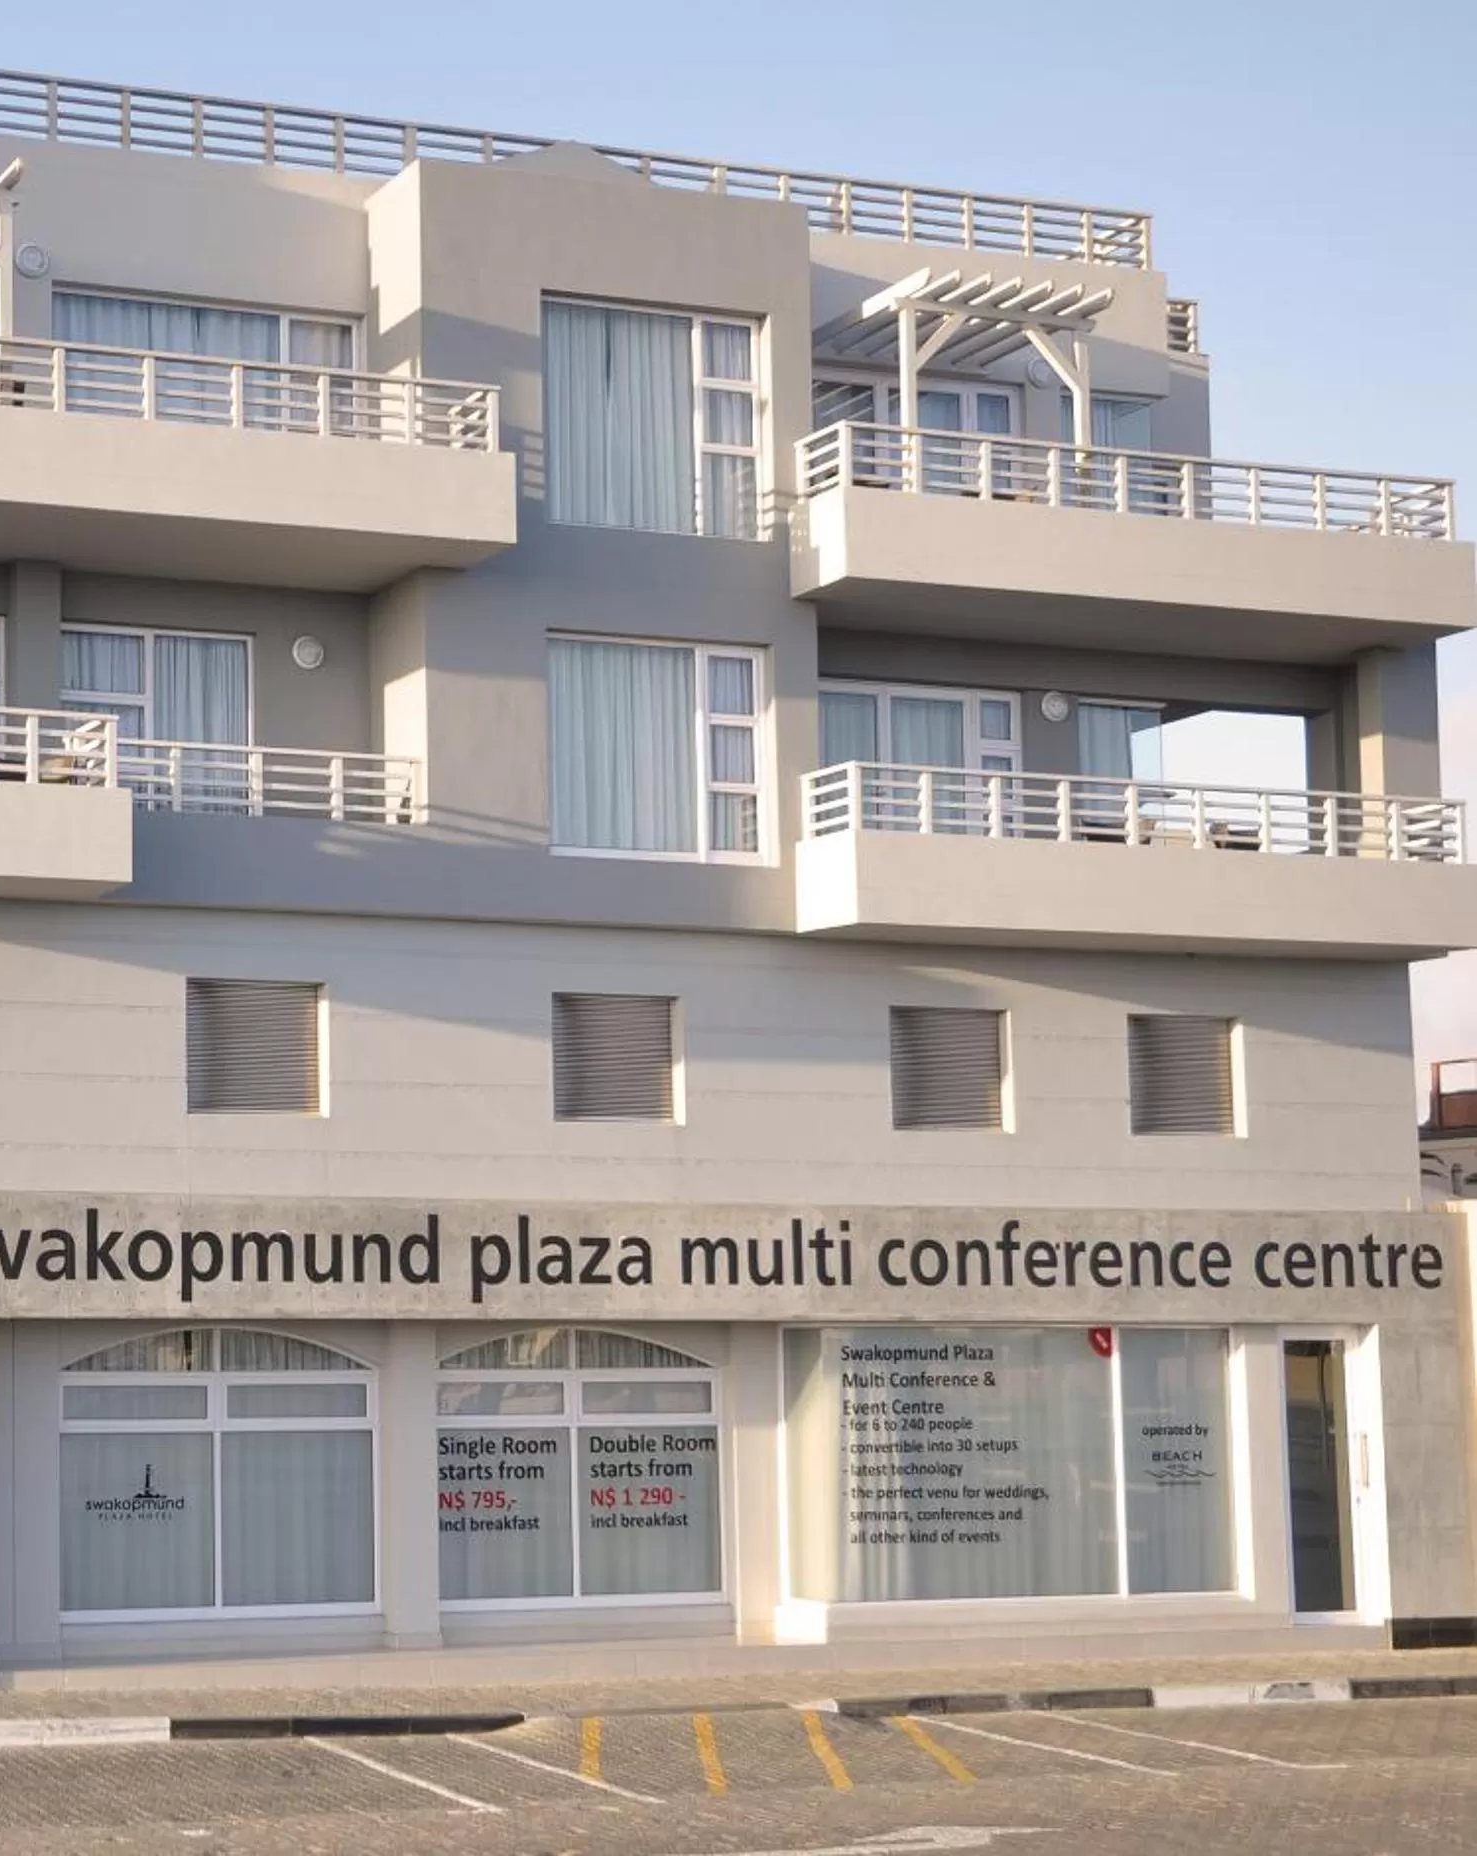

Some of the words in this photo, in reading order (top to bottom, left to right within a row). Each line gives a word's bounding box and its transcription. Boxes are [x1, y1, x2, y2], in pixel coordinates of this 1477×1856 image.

[472, 1215, 654, 1303] plaza
[680, 1218, 853, 1286] multi
[878, 1220, 1233, 1288] conference
[1255, 1231, 1443, 1289] centre
[841, 1344, 948, 1364] Swakopmund
[953, 1344, 994, 1360] Plaza
[842, 1372, 885, 1388] Multi
[890, 1371, 979, 1388] Conference
[983, 1371, 996, 1387] &
[842, 1400, 887, 1416] Event
[892, 1399, 944, 1414] Centre
[850, 1418, 867, 1431] for
[884, 1419, 897, 1431] to
[901, 1418, 925, 1431] 240
[928, 1416, 973, 1433] people
[1141, 1424, 1192, 1438] operated
[1195, 1424, 1208, 1438] by
[439, 1436, 496, 1459] Single
[502, 1437, 556, 1454] Room
[590, 1434, 657, 1454] Double
[663, 1436, 716, 1452] Room
[850, 1439, 924, 1454] convertible
[927, 1438, 953, 1452] into
[956, 1438, 973, 1452] 30
[976, 1439, 1019, 1454] setups
[439, 1464, 494, 1480] starts
[499, 1460, 544, 1479] from
[590, 1461, 642, 1478] starts
[645, 1459, 692, 1477] from
[850, 1463, 887, 1476] latest
[891, 1461, 963, 1477] technology
[590, 1486, 616, 1509] N$
[851, 1485, 873, 1498] the
[877, 1485, 923, 1499] perfect
[927, 1487, 958, 1498] venu
[963, 1484, 981, 1498] for
[85, 1497, 184, 1512] swakopmund
[439, 1490, 465, 1512] N$
[590, 1513, 616, 1528] incl
[620, 1512, 688, 1528] breakfast
[917, 1507, 995, 1520] conferences
[998, 1508, 1023, 1520] and
[439, 1516, 465, 1532] incl
[470, 1515, 541, 1531] breakfast
[850, 1530, 866, 1544] all
[870, 1529, 905, 1544] other
[909, 1528, 938, 1544] kind
[941, 1529, 955, 1543] of
[958, 1531, 1001, 1544] events
